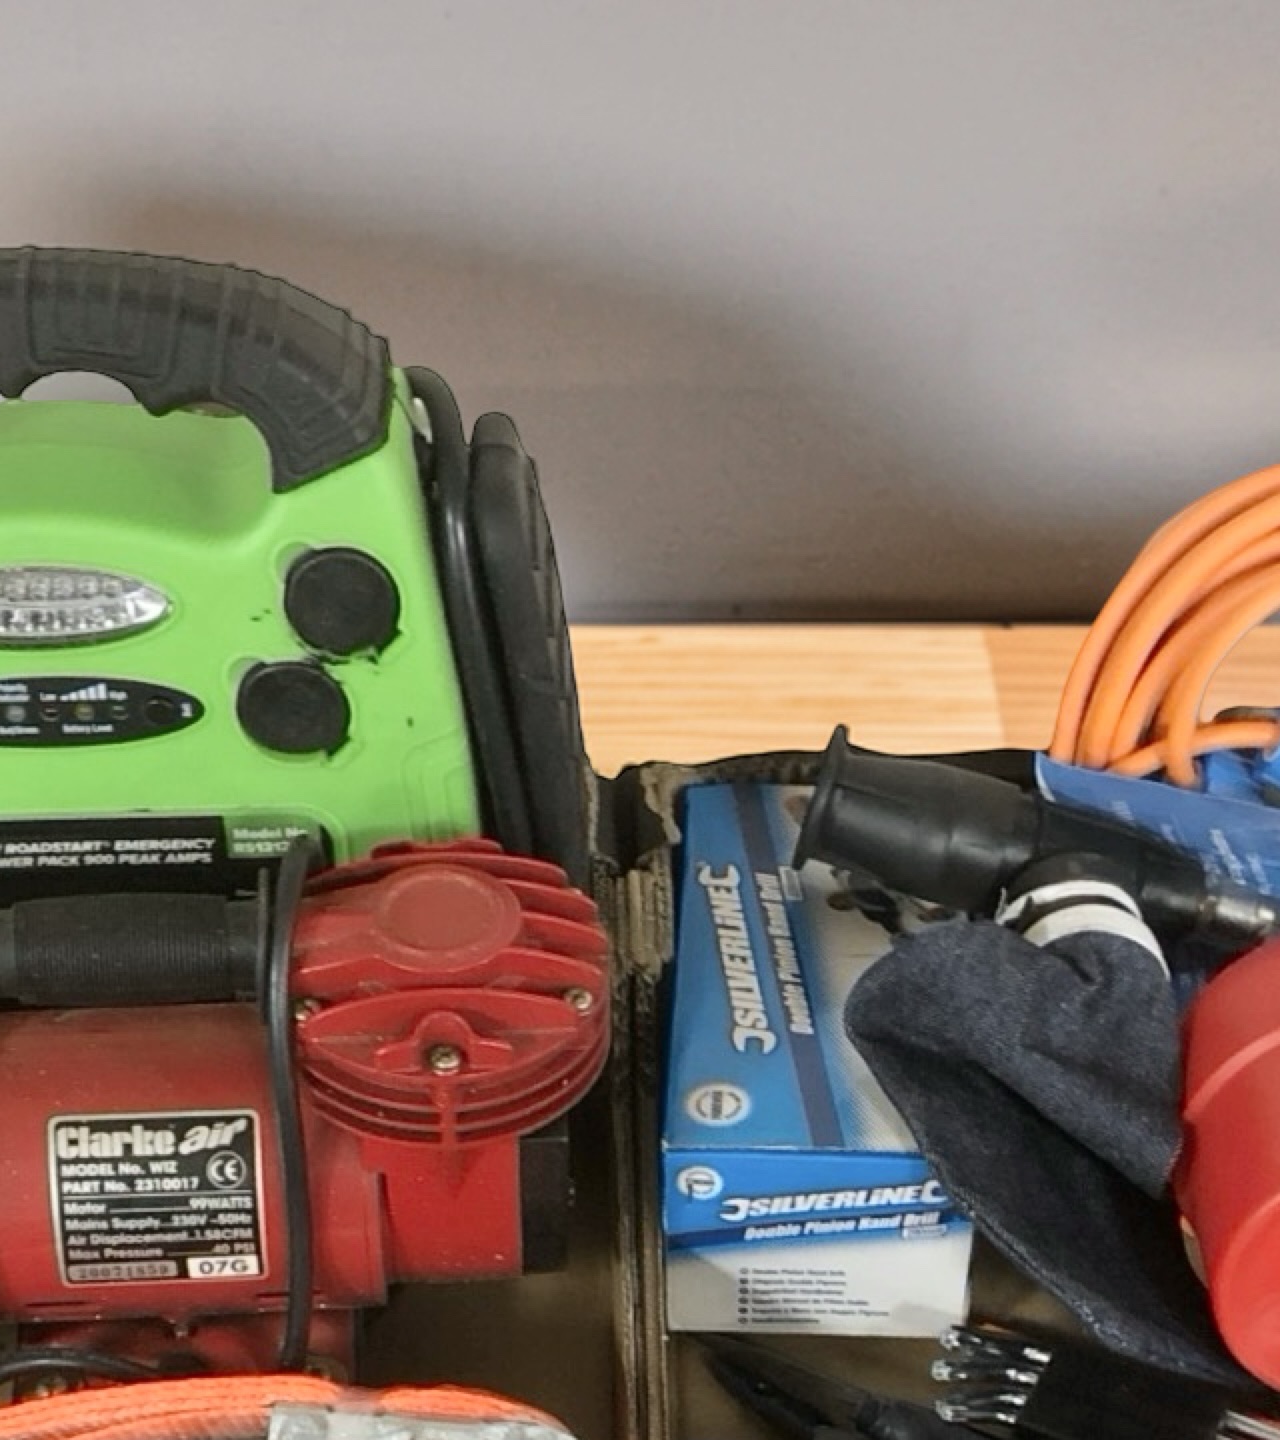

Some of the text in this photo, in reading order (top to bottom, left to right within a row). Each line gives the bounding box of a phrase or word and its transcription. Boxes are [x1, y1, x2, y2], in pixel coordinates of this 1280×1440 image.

[113, 837, 216, 852] EMERGENCY
[37, 855, 81, 867] PACK
[117, 853, 161, 865] PEAK
[164, 851, 213, 863] AMPS
[706, 878, 770, 1036] SILVERLINE
[56, 1124, 177, 1159] Clarke
[61, 1162, 116, 1177] MODEL
[61, 1180, 101, 1193] PART
[738, 1182, 934, 1219] SILVERLINE
[743, 1223, 801, 1241] Double
[803, 1219, 857, 1235] Pinion
[858, 1214, 902, 1231] Hand
